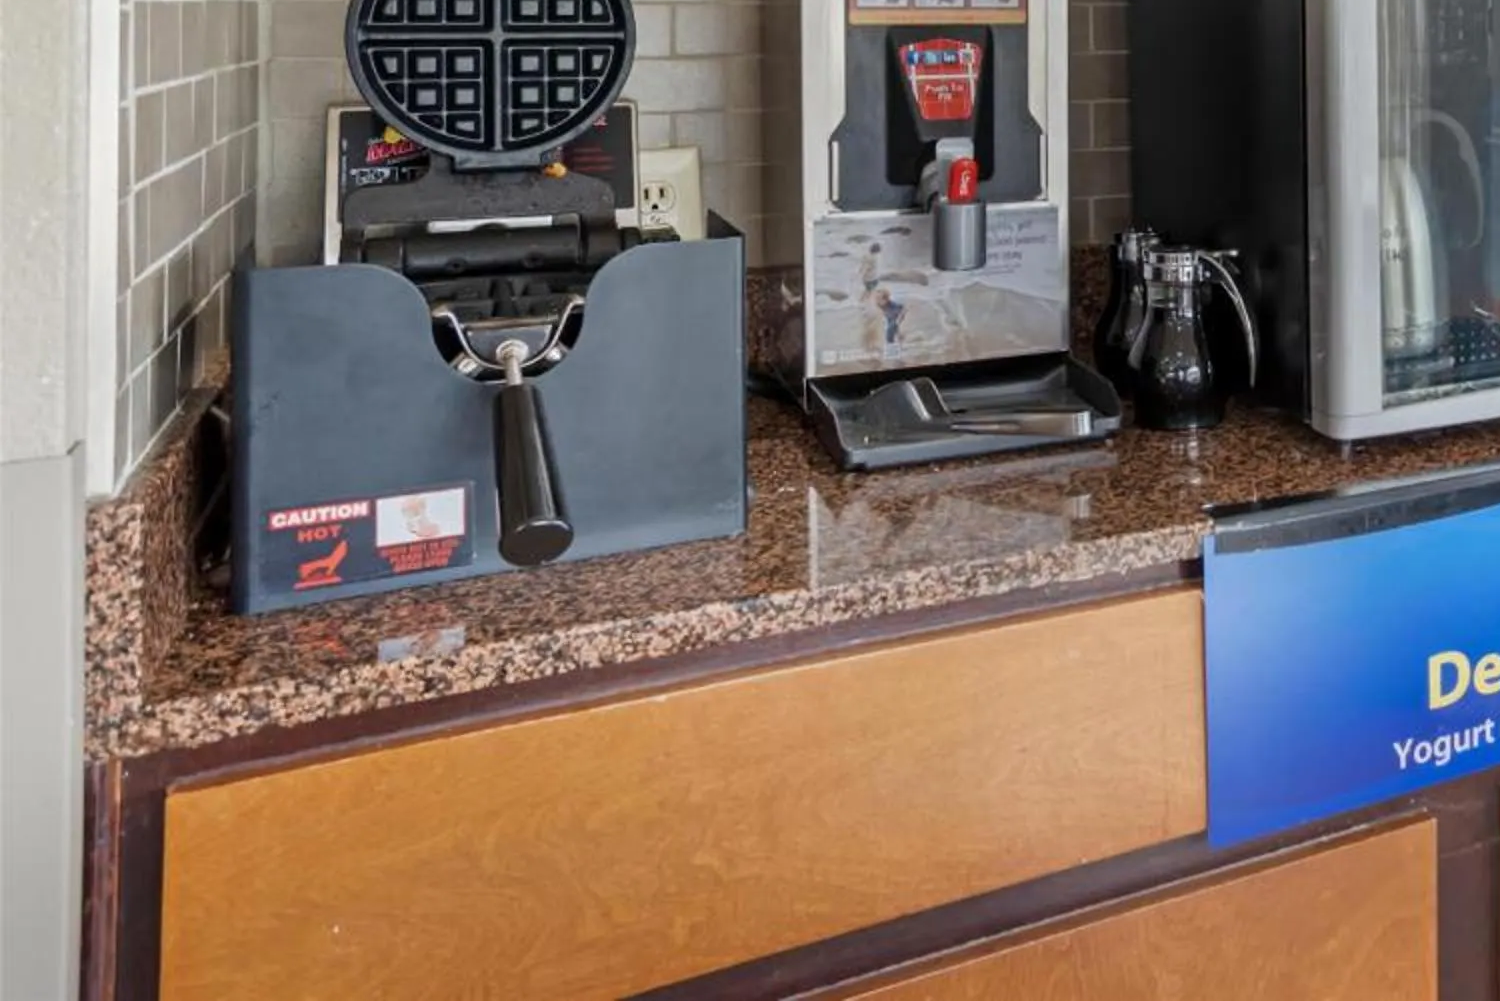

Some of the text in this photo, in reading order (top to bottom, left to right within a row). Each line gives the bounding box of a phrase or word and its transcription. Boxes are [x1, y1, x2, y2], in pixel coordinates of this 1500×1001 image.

[270, 500, 369, 529] CAUTION
[297, 524, 342, 543] HOT
[1393, 718, 1494, 770] Yogurt
